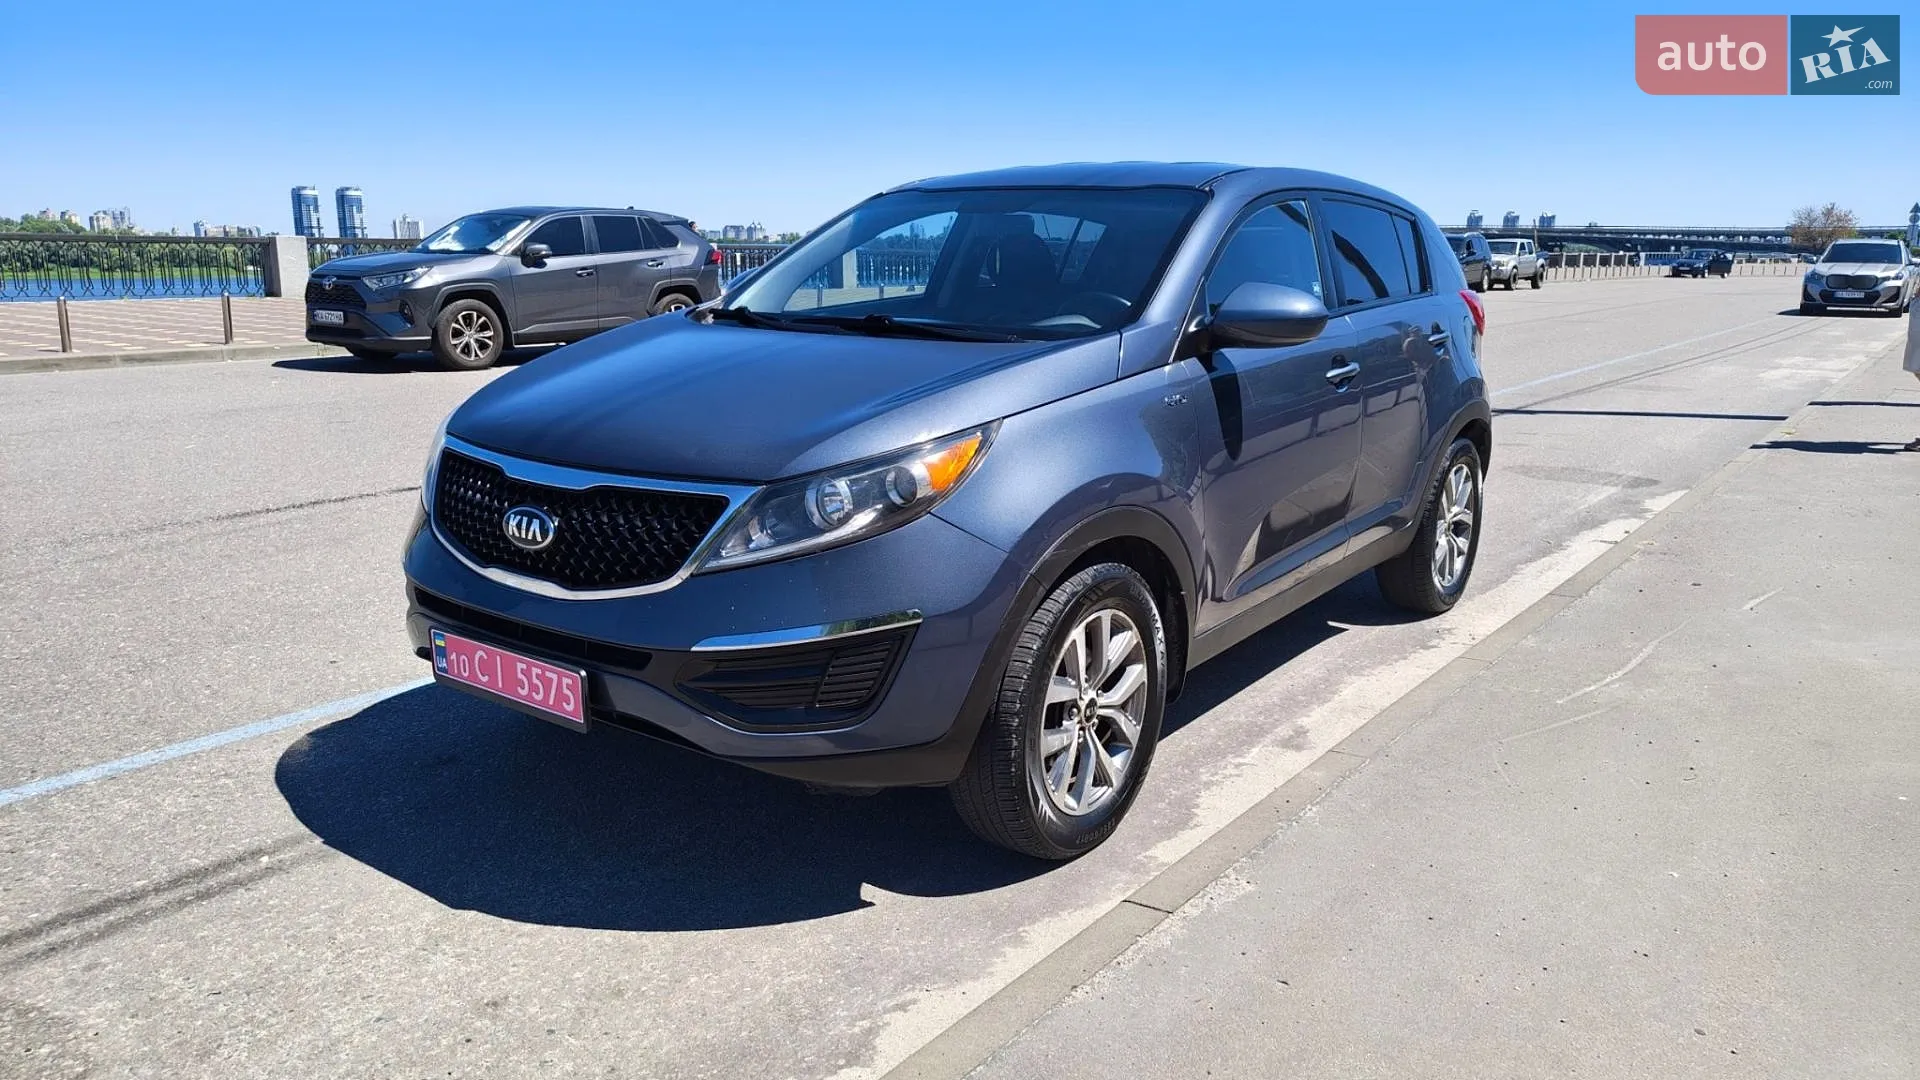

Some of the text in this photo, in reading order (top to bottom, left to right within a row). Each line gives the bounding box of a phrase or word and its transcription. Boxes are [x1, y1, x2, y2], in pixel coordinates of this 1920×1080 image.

[508, 514, 542, 542] KIA
[436, 655, 448, 669] UA
[516, 662, 575, 712] 5575
